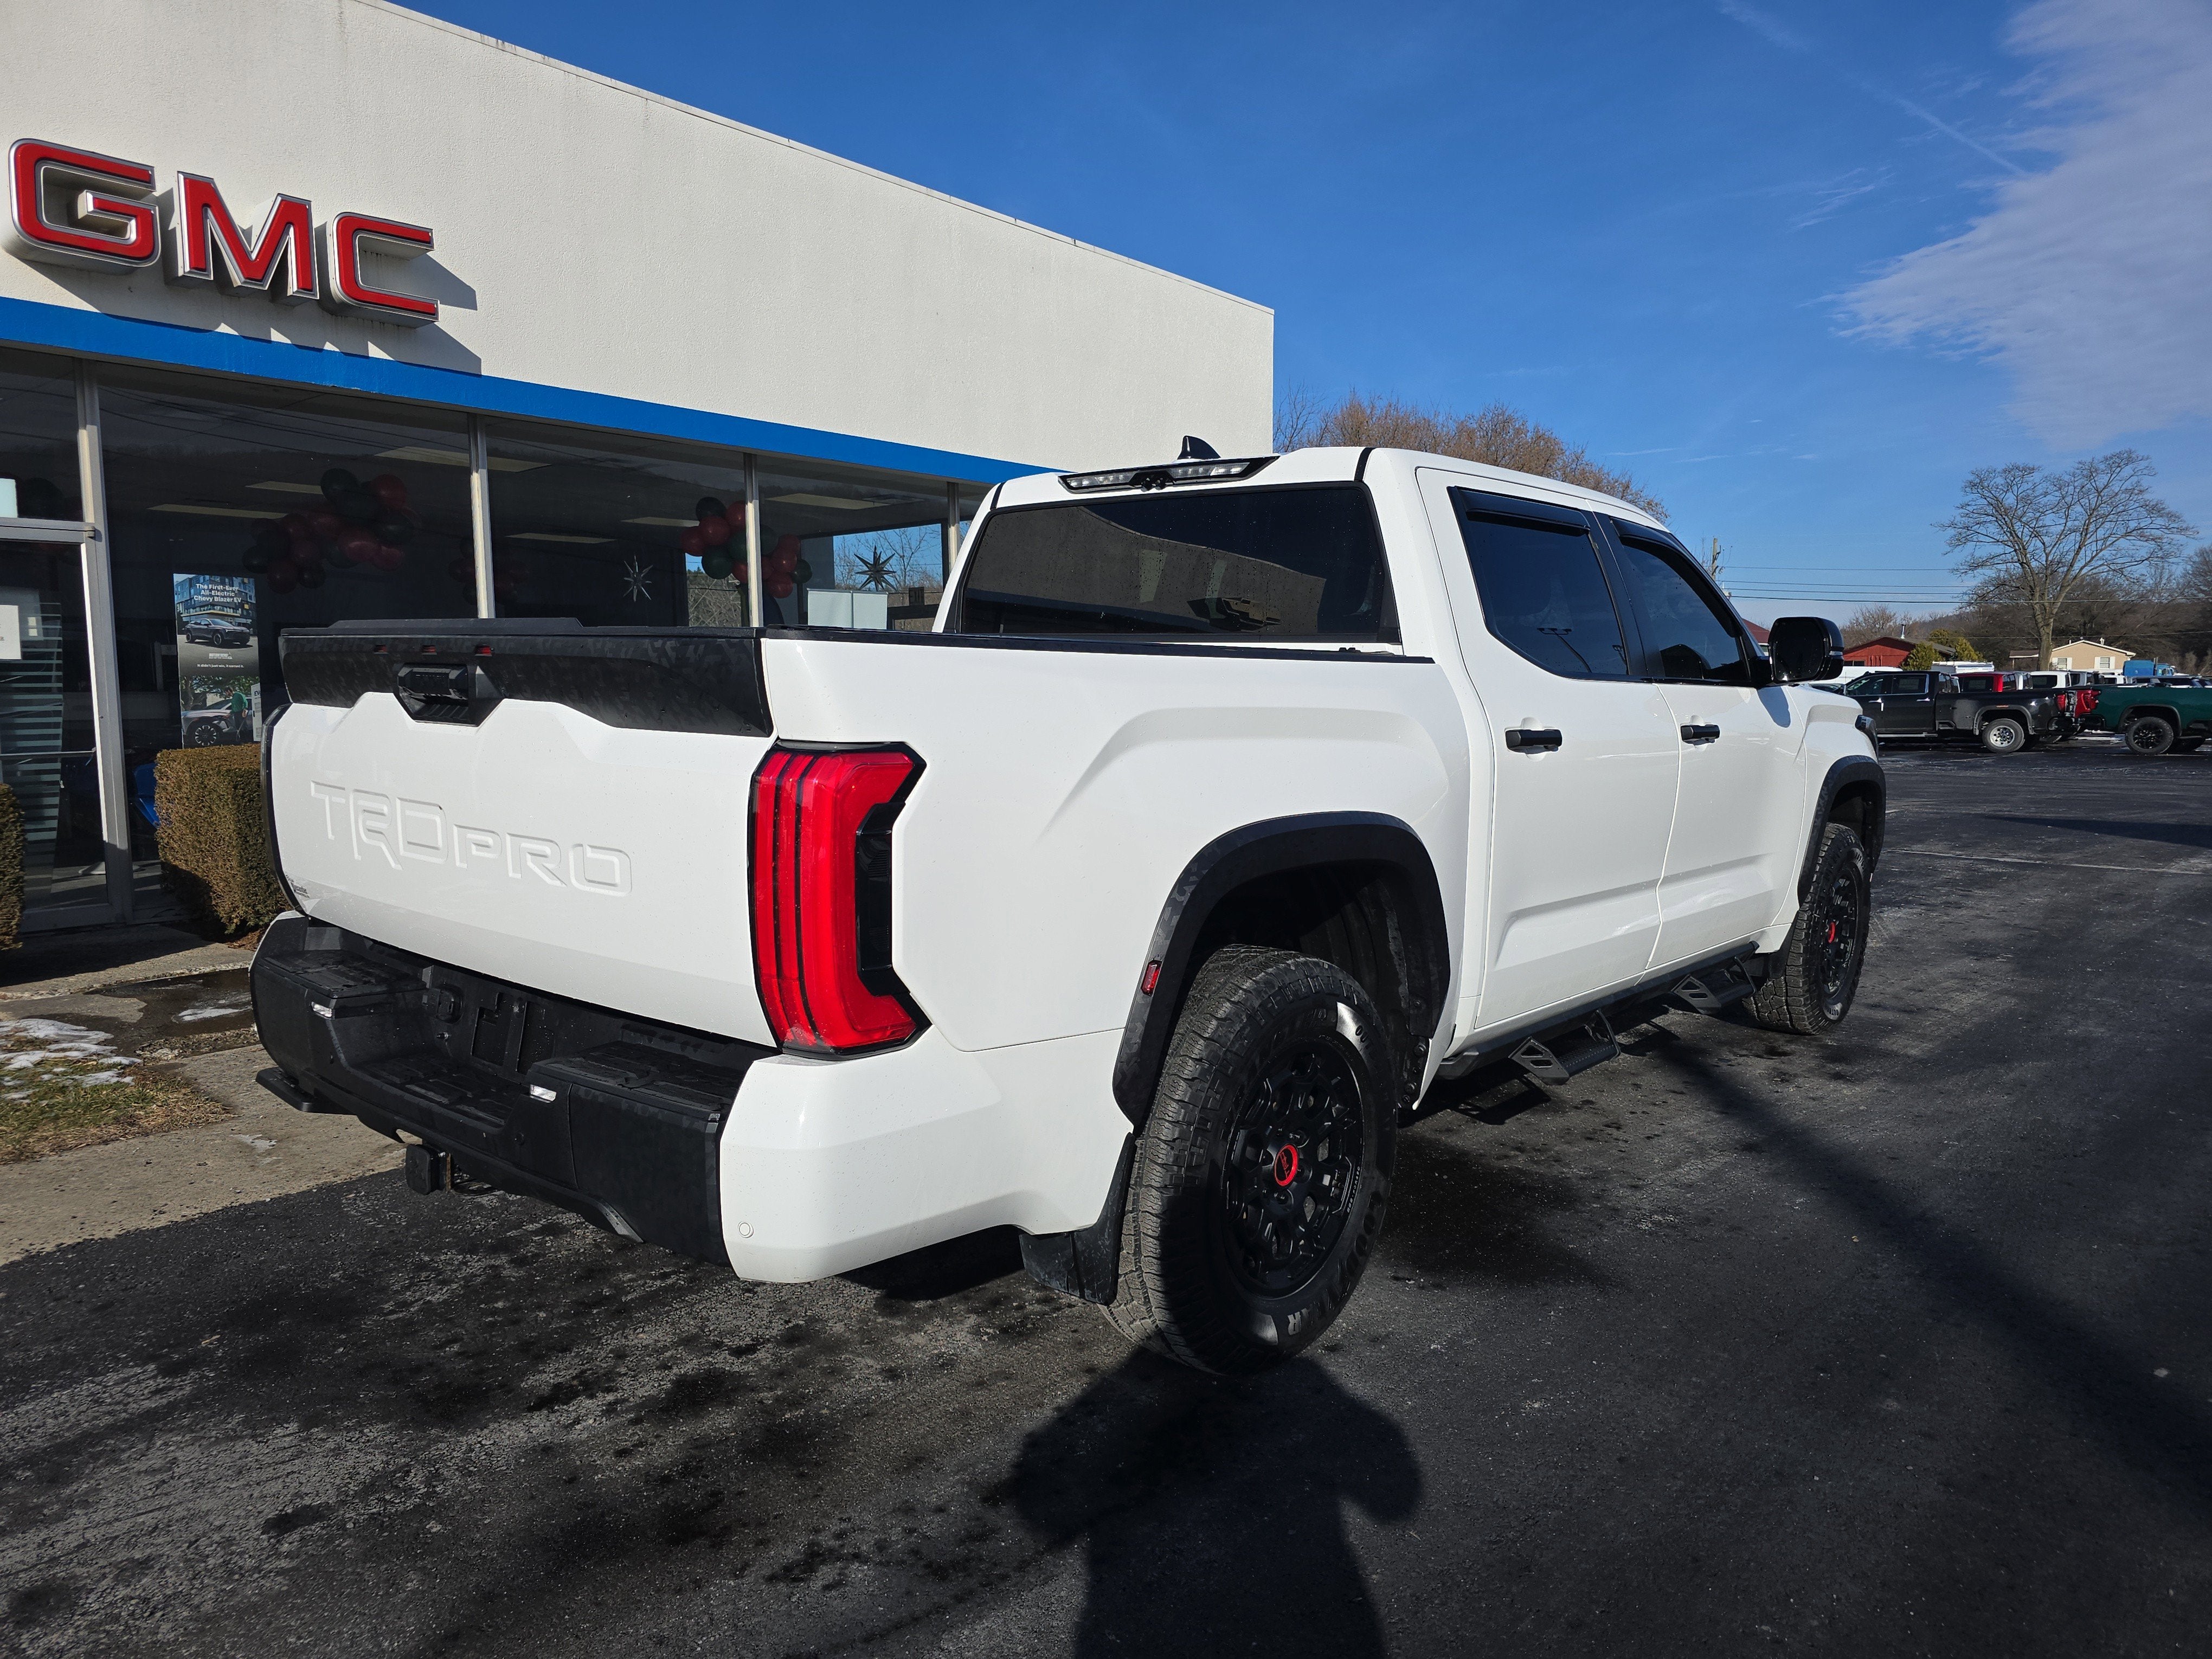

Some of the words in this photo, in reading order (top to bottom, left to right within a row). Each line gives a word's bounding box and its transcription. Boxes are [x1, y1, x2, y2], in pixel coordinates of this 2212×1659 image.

[8, 138, 440, 324] GMC
[310, 780, 449, 871] TRD
[453, 824, 633, 897] PRO
